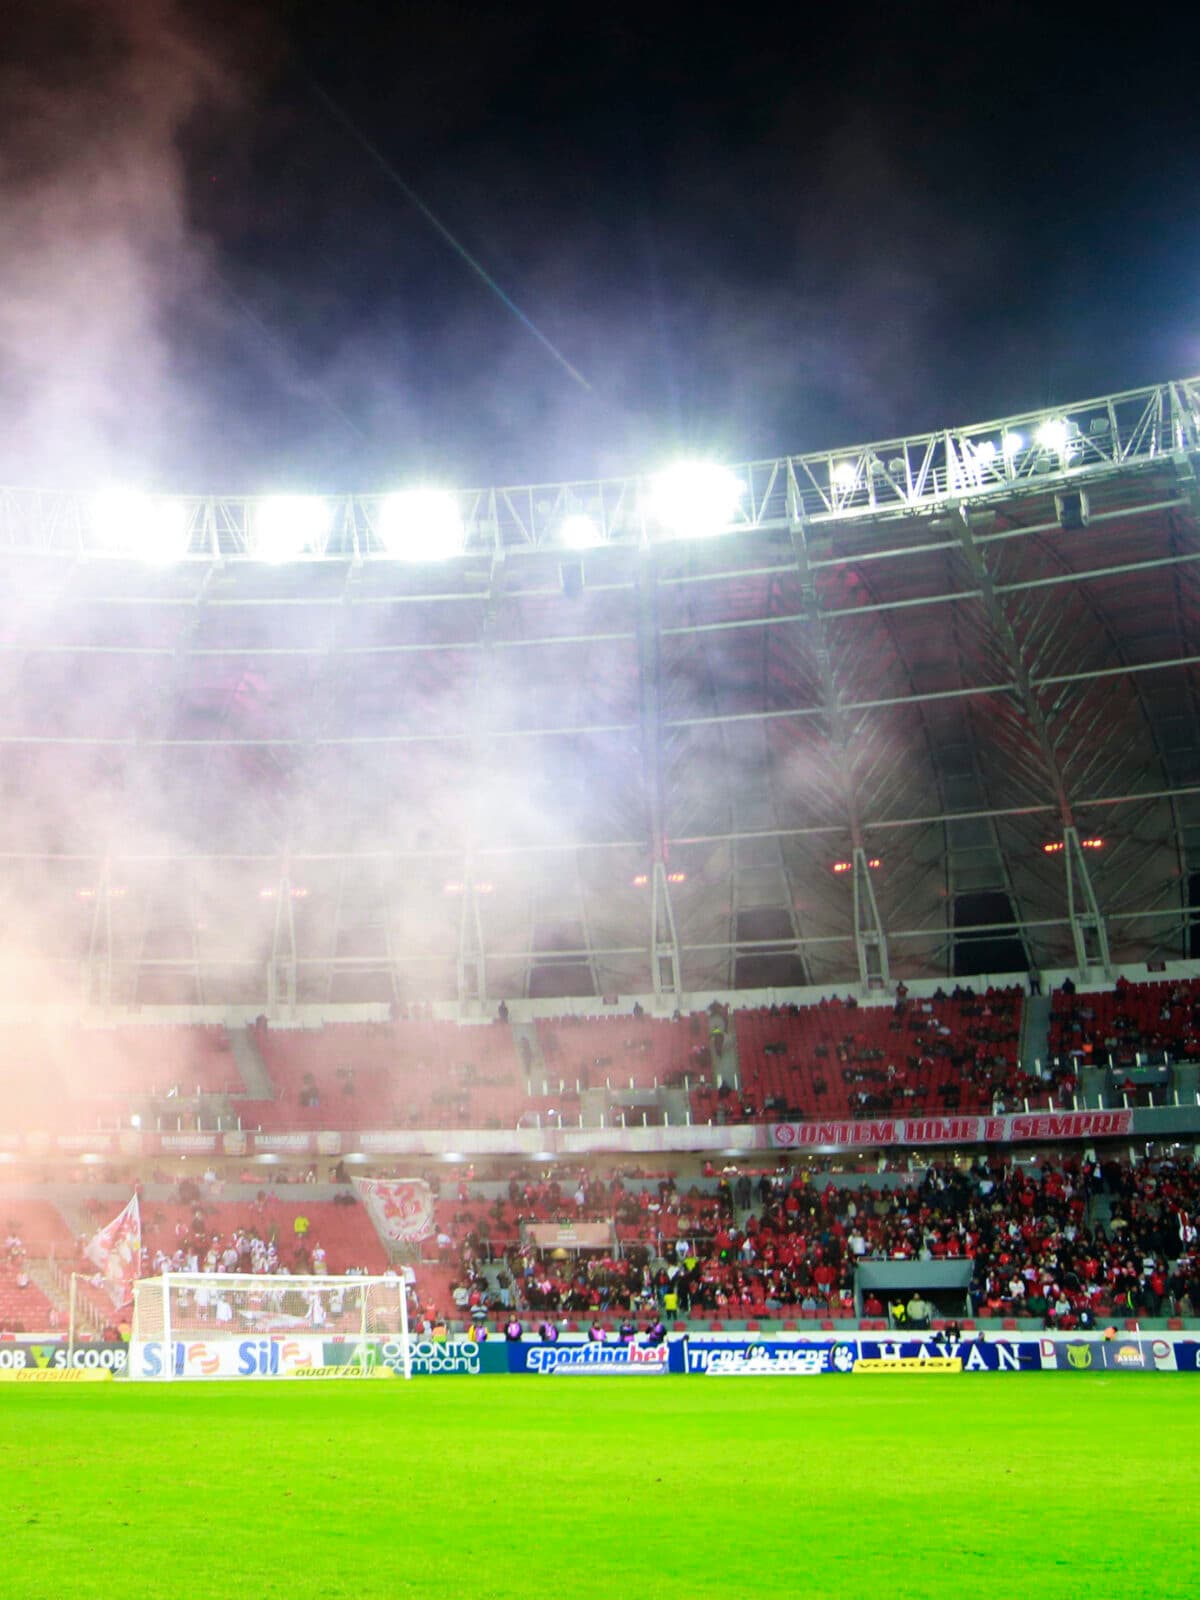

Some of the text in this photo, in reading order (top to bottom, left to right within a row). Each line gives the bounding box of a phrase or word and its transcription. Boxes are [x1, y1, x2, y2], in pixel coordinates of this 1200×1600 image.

[905, 1118, 978, 1141] HOJE
[985, 1116, 1004, 1140] E
[1011, 1110, 1132, 1138] SEMPRE
[238, 1340, 279, 1375] Sil
[526, 1342, 669, 1374] sportingbet
